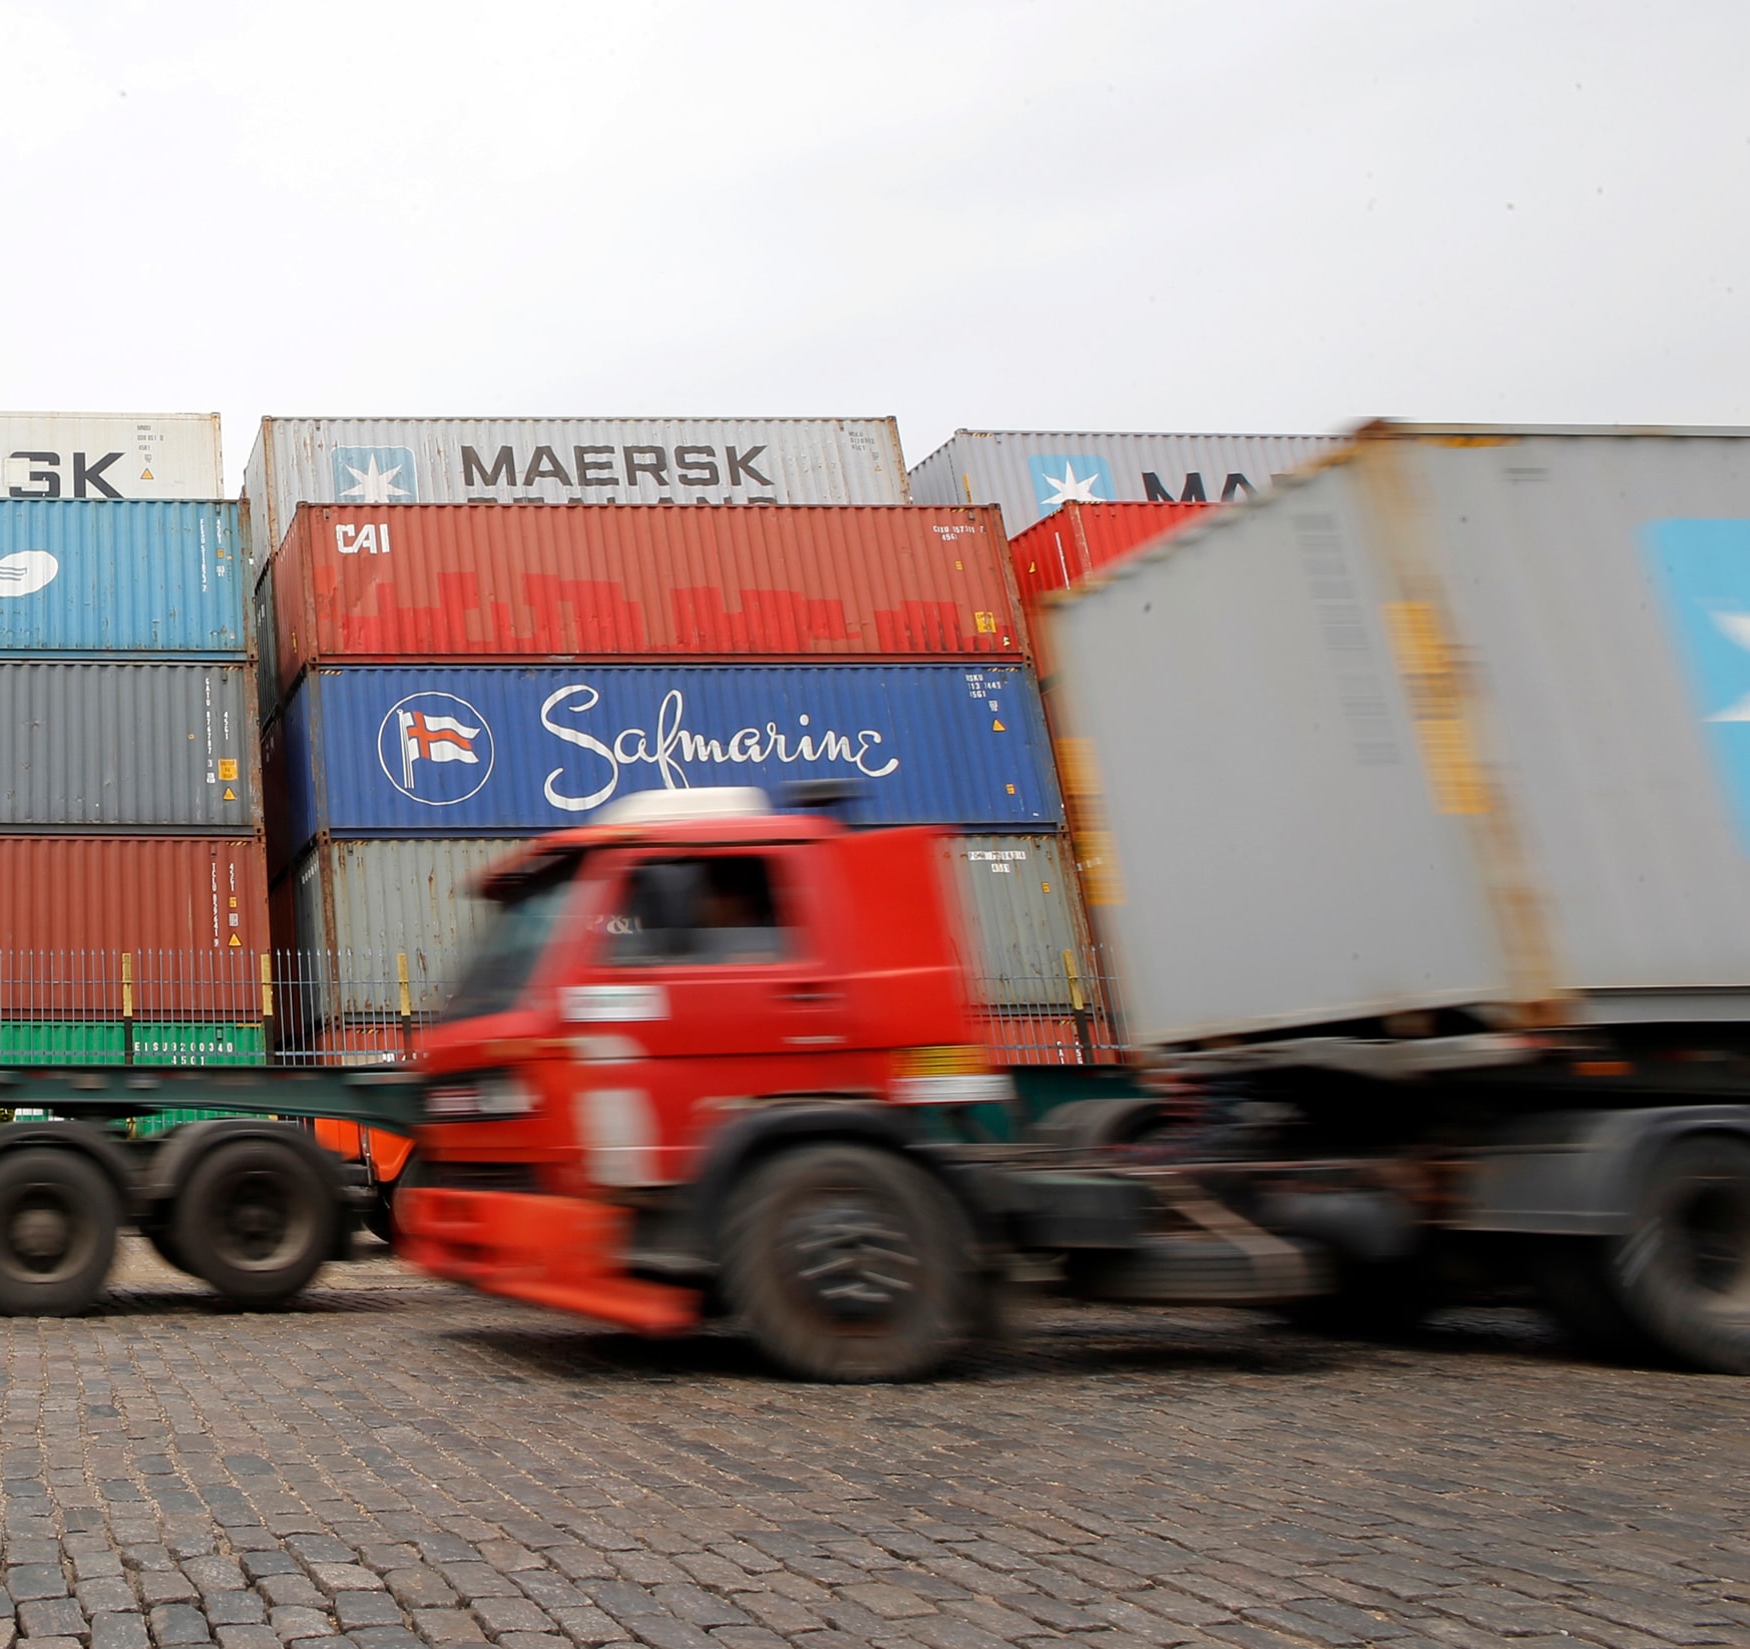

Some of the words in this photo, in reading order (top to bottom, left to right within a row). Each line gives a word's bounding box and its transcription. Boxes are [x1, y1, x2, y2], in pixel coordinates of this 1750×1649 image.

[460, 445, 775, 488] MAERSK
[335, 523, 391, 555] CAI
[541, 684, 899, 811] Safmarine
